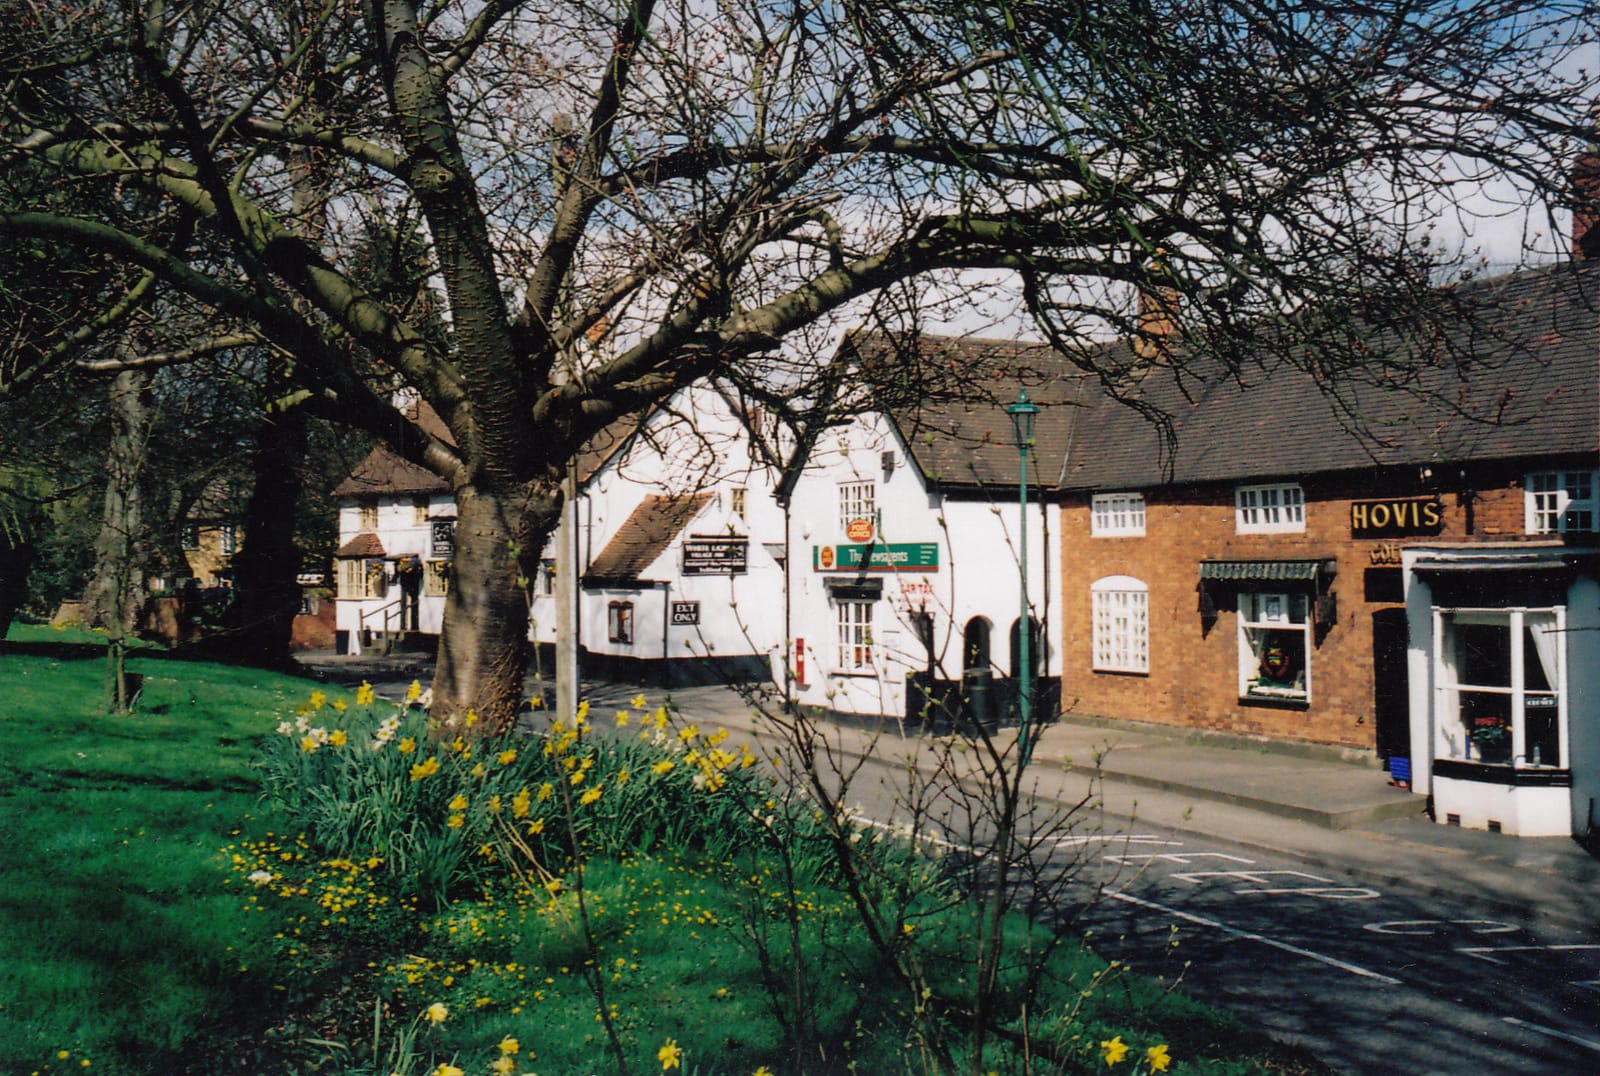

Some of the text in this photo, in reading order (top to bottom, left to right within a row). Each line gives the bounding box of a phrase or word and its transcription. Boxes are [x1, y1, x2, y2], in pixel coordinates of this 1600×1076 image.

[1352, 502, 1439, 529] HOVIS
[866, 549, 908, 565] ewsagents
[674, 613, 696, 622] ONLY
[1024, 834, 1382, 899] KEEP
